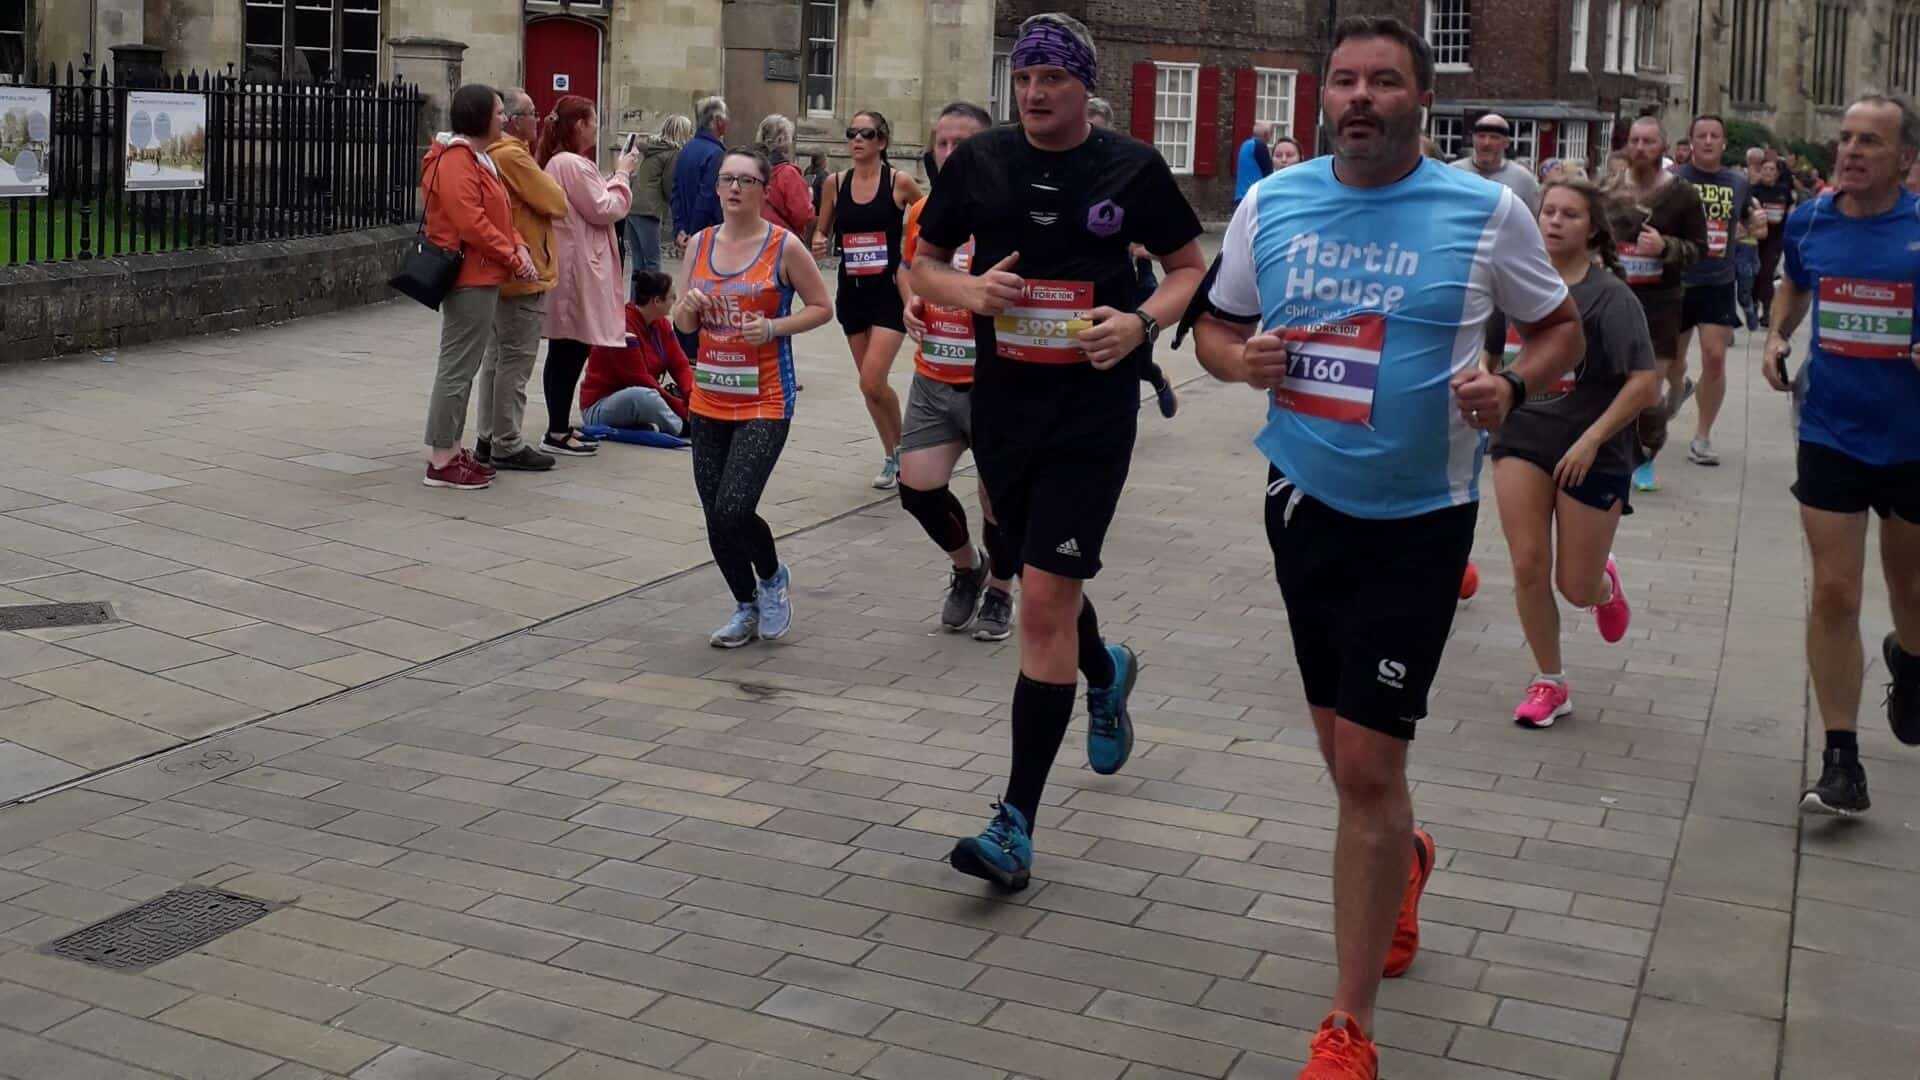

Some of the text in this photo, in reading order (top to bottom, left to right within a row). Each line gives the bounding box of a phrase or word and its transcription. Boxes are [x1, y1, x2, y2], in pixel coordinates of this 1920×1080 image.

[853, 252, 877, 262] 6764
[1286, 232, 1419, 276] Martin
[1285, 267, 1404, 312] House
[710, 295, 740, 312] NE
[1017, 319, 1068, 337] 5993
[1838, 315, 1888, 333] 5215
[933, 344, 966, 357] 7520
[1288, 354, 1346, 383] 7160
[709, 373, 741, 386] 7461
